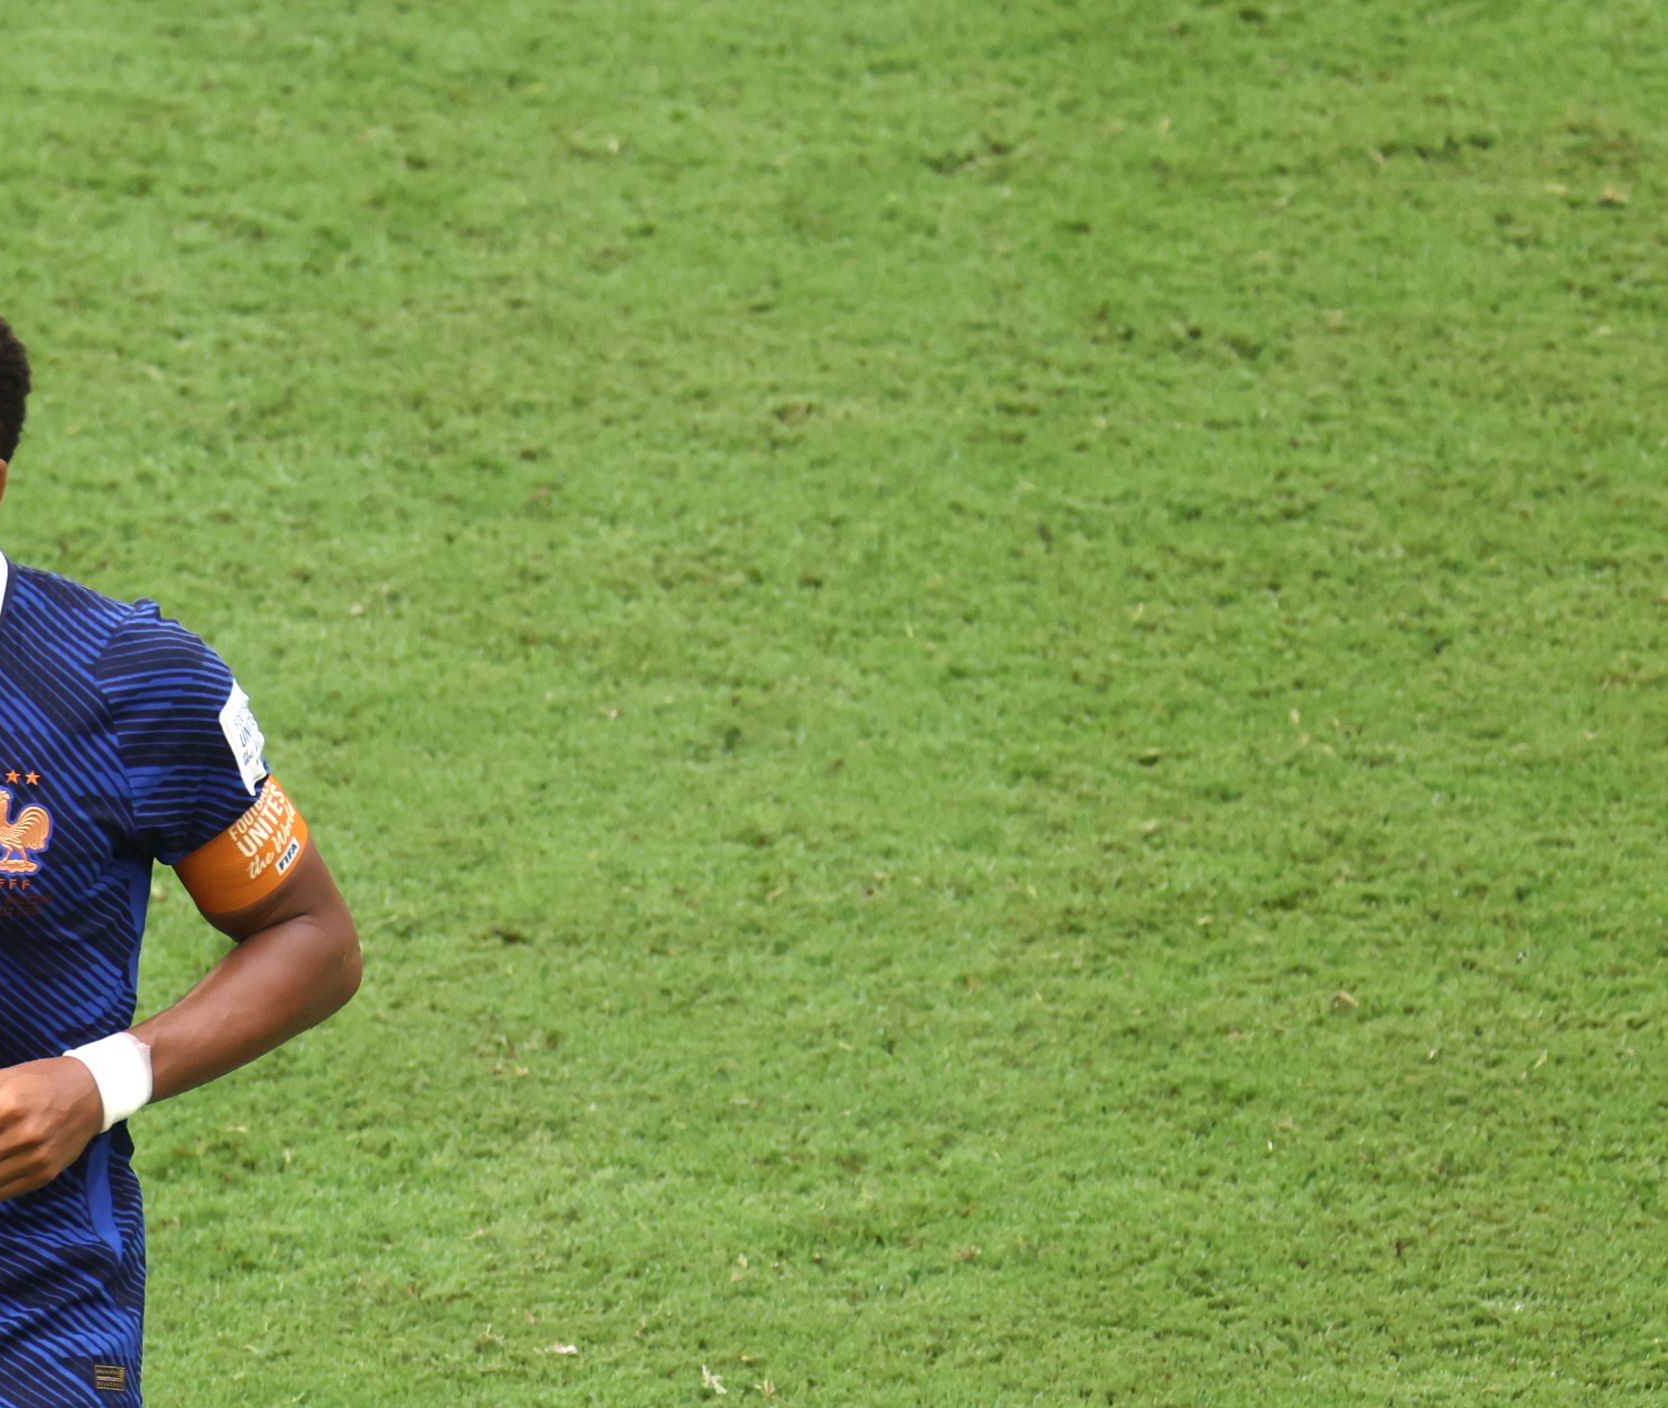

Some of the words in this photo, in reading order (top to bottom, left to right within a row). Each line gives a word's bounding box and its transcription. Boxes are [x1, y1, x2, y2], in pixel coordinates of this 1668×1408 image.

[236, 784, 284, 857] UNITES
[246, 854, 274, 879] the
[278, 843, 298, 871] FIFA
